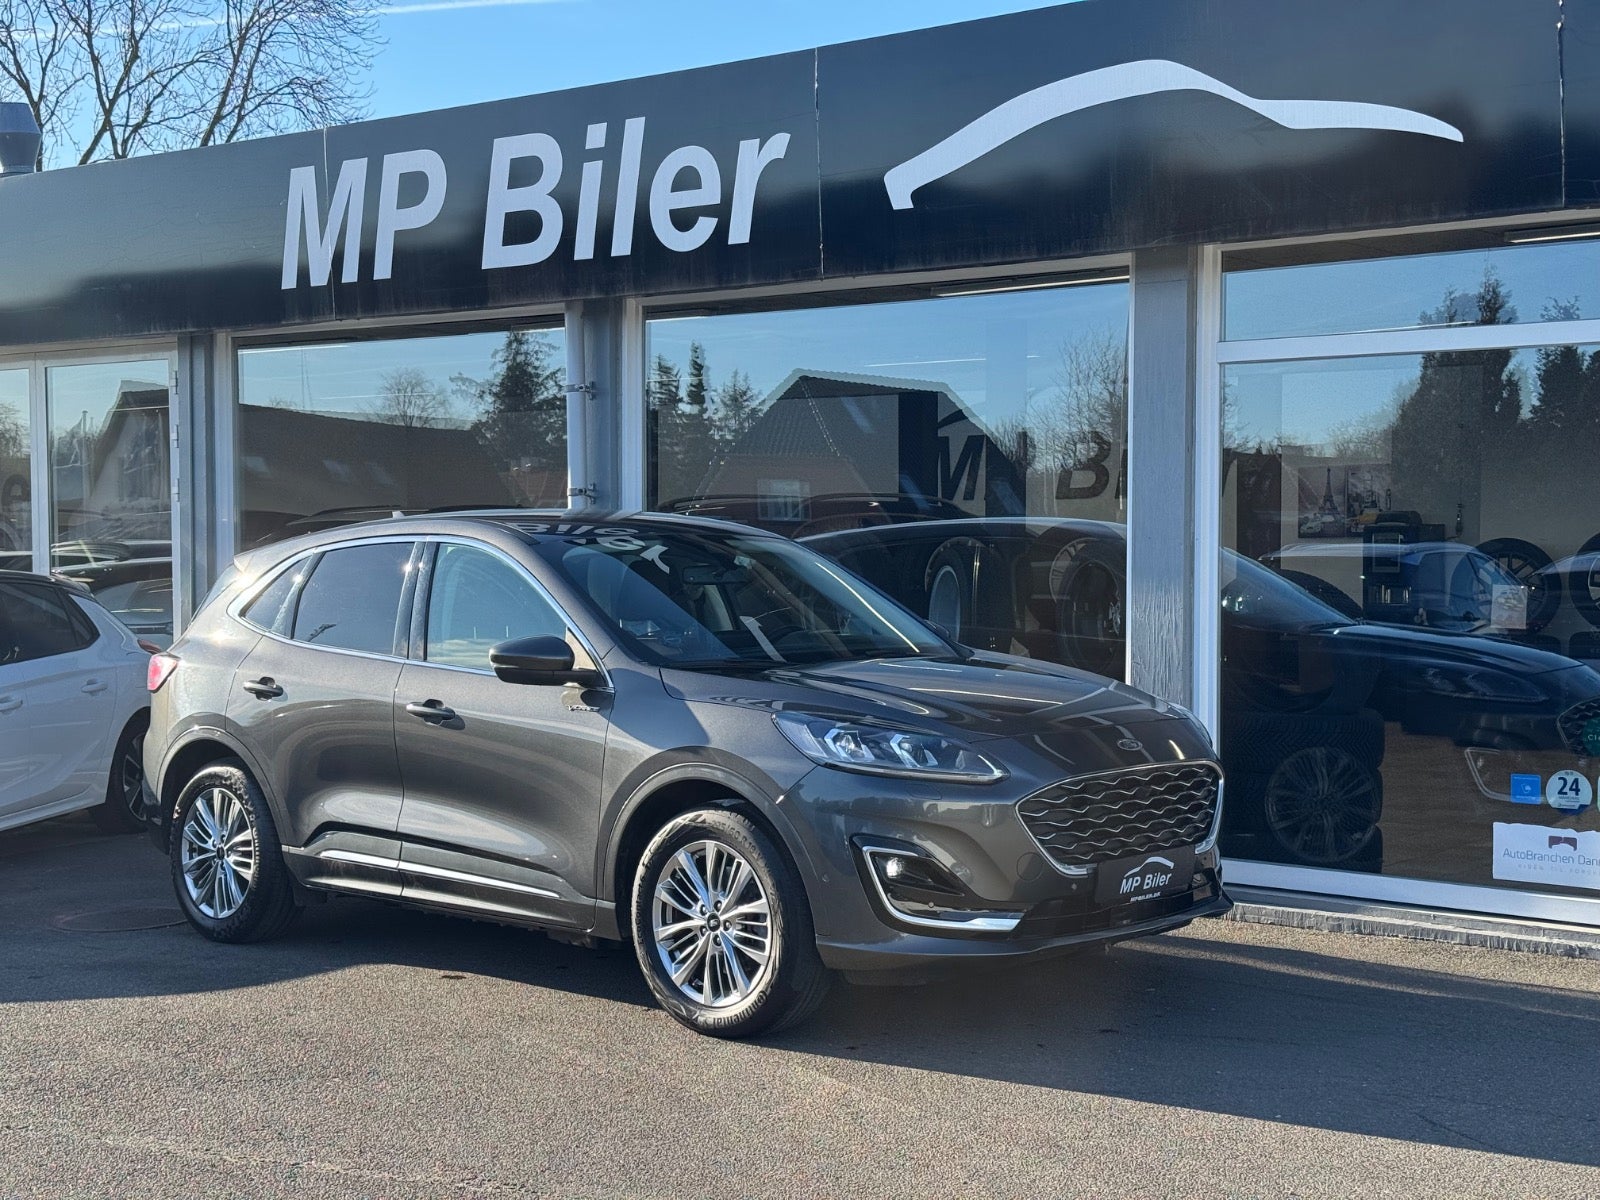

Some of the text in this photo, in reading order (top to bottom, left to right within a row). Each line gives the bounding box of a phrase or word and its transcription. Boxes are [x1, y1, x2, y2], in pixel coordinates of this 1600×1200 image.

[281, 116, 791, 290] MP Biler
[1557, 776, 1581, 797] 24
[1502, 848, 1575, 864] AutoBranchen
[1120, 872, 1172, 894] MP Biler
